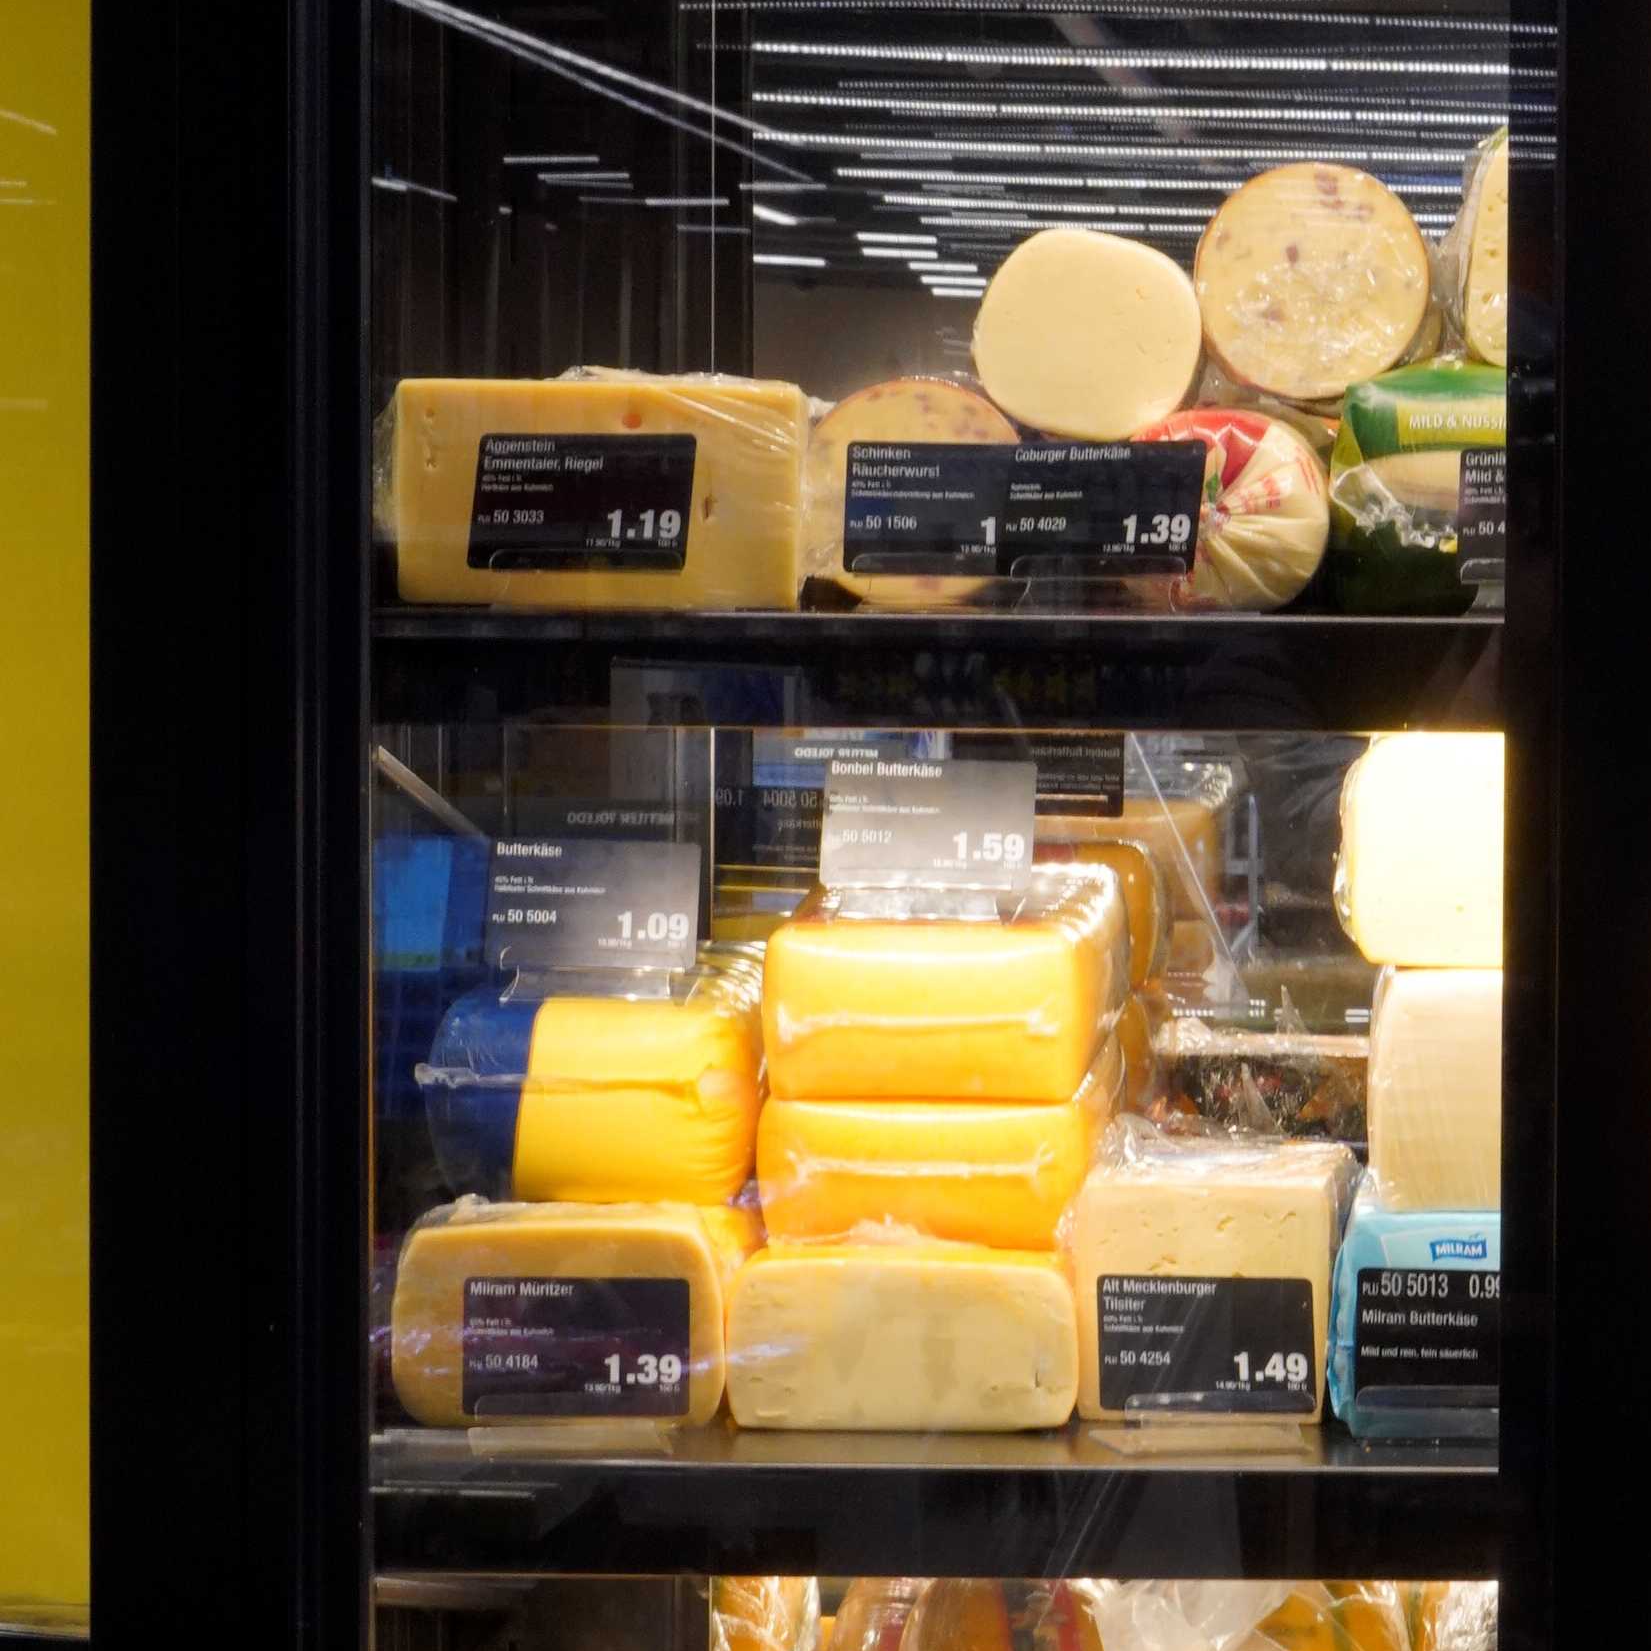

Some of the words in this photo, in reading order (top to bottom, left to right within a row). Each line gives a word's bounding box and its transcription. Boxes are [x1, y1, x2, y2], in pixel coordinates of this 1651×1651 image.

[1410, 413, 1442, 429] MILD
[1447, 413, 1456, 429] &
[485, 439, 556, 453] Aggenstein
[853, 446, 911, 459] Schinken
[1070, 446, 1131, 462] Butterkäse
[483, 457, 561, 471] Emmentaler,
[565, 457, 604, 472] Riegel
[853, 462, 940, 477] Räucherwurst
[1465, 469, 1491, 484] Mild
[1495, 469, 1505, 484] &
[493, 510, 509, 523] 50
[513, 510, 544, 523] 3033
[607, 509, 682, 538] 1.19
[866, 516, 881, 529] 50
[887, 516, 917, 529] 1506
[1019, 518, 1034, 531] 50
[1037, 517, 1067, 530] 4029
[1122, 514, 1191, 544] 1.39
[1478, 521, 1494, 535] 50
[832, 761, 873, 775] Bonbel
[877, 762, 943, 777] Butterkäse
[497, 842, 562, 857] Butterkäse
[953, 832, 1025, 861] 1.59
[508, 910, 523, 922] 50
[527, 910, 557, 923] 5004
[617, 911, 689, 940] 1.09
[1436, 1243, 1482, 1256] MILRAM
[470, 1282, 516, 1296] Milram
[520, 1281, 575, 1296] Müritzer
[1103, 1279, 1120, 1293] Alt
[1123, 1281, 1216, 1296] Mecklenburger
[1363, 1282, 1379, 1295] PLU
[1381, 1272, 1402, 1296] 50
[1407, 1273, 1448, 1297] 5013
[1104, 1297, 1146, 1311] Tilsiter
[1362, 1309, 1405, 1324] Milram
[1410, 1310, 1479, 1327] Butterkäse
[1120, 1351, 1136, 1365] 50
[1139, 1351, 1170, 1365] 4254
[1361, 1346, 1379, 1357] Mild
[1382, 1347, 1398, 1358] und
[1421, 1348, 1437, 1358] fein
[1439, 1348, 1478, 1359] säuerlich
[486, 1355, 501, 1369] 50
[506, 1354, 538, 1369] 4184
[604, 1353, 682, 1384] 1.39
[1234, 1351, 1308, 1382] 1.49
